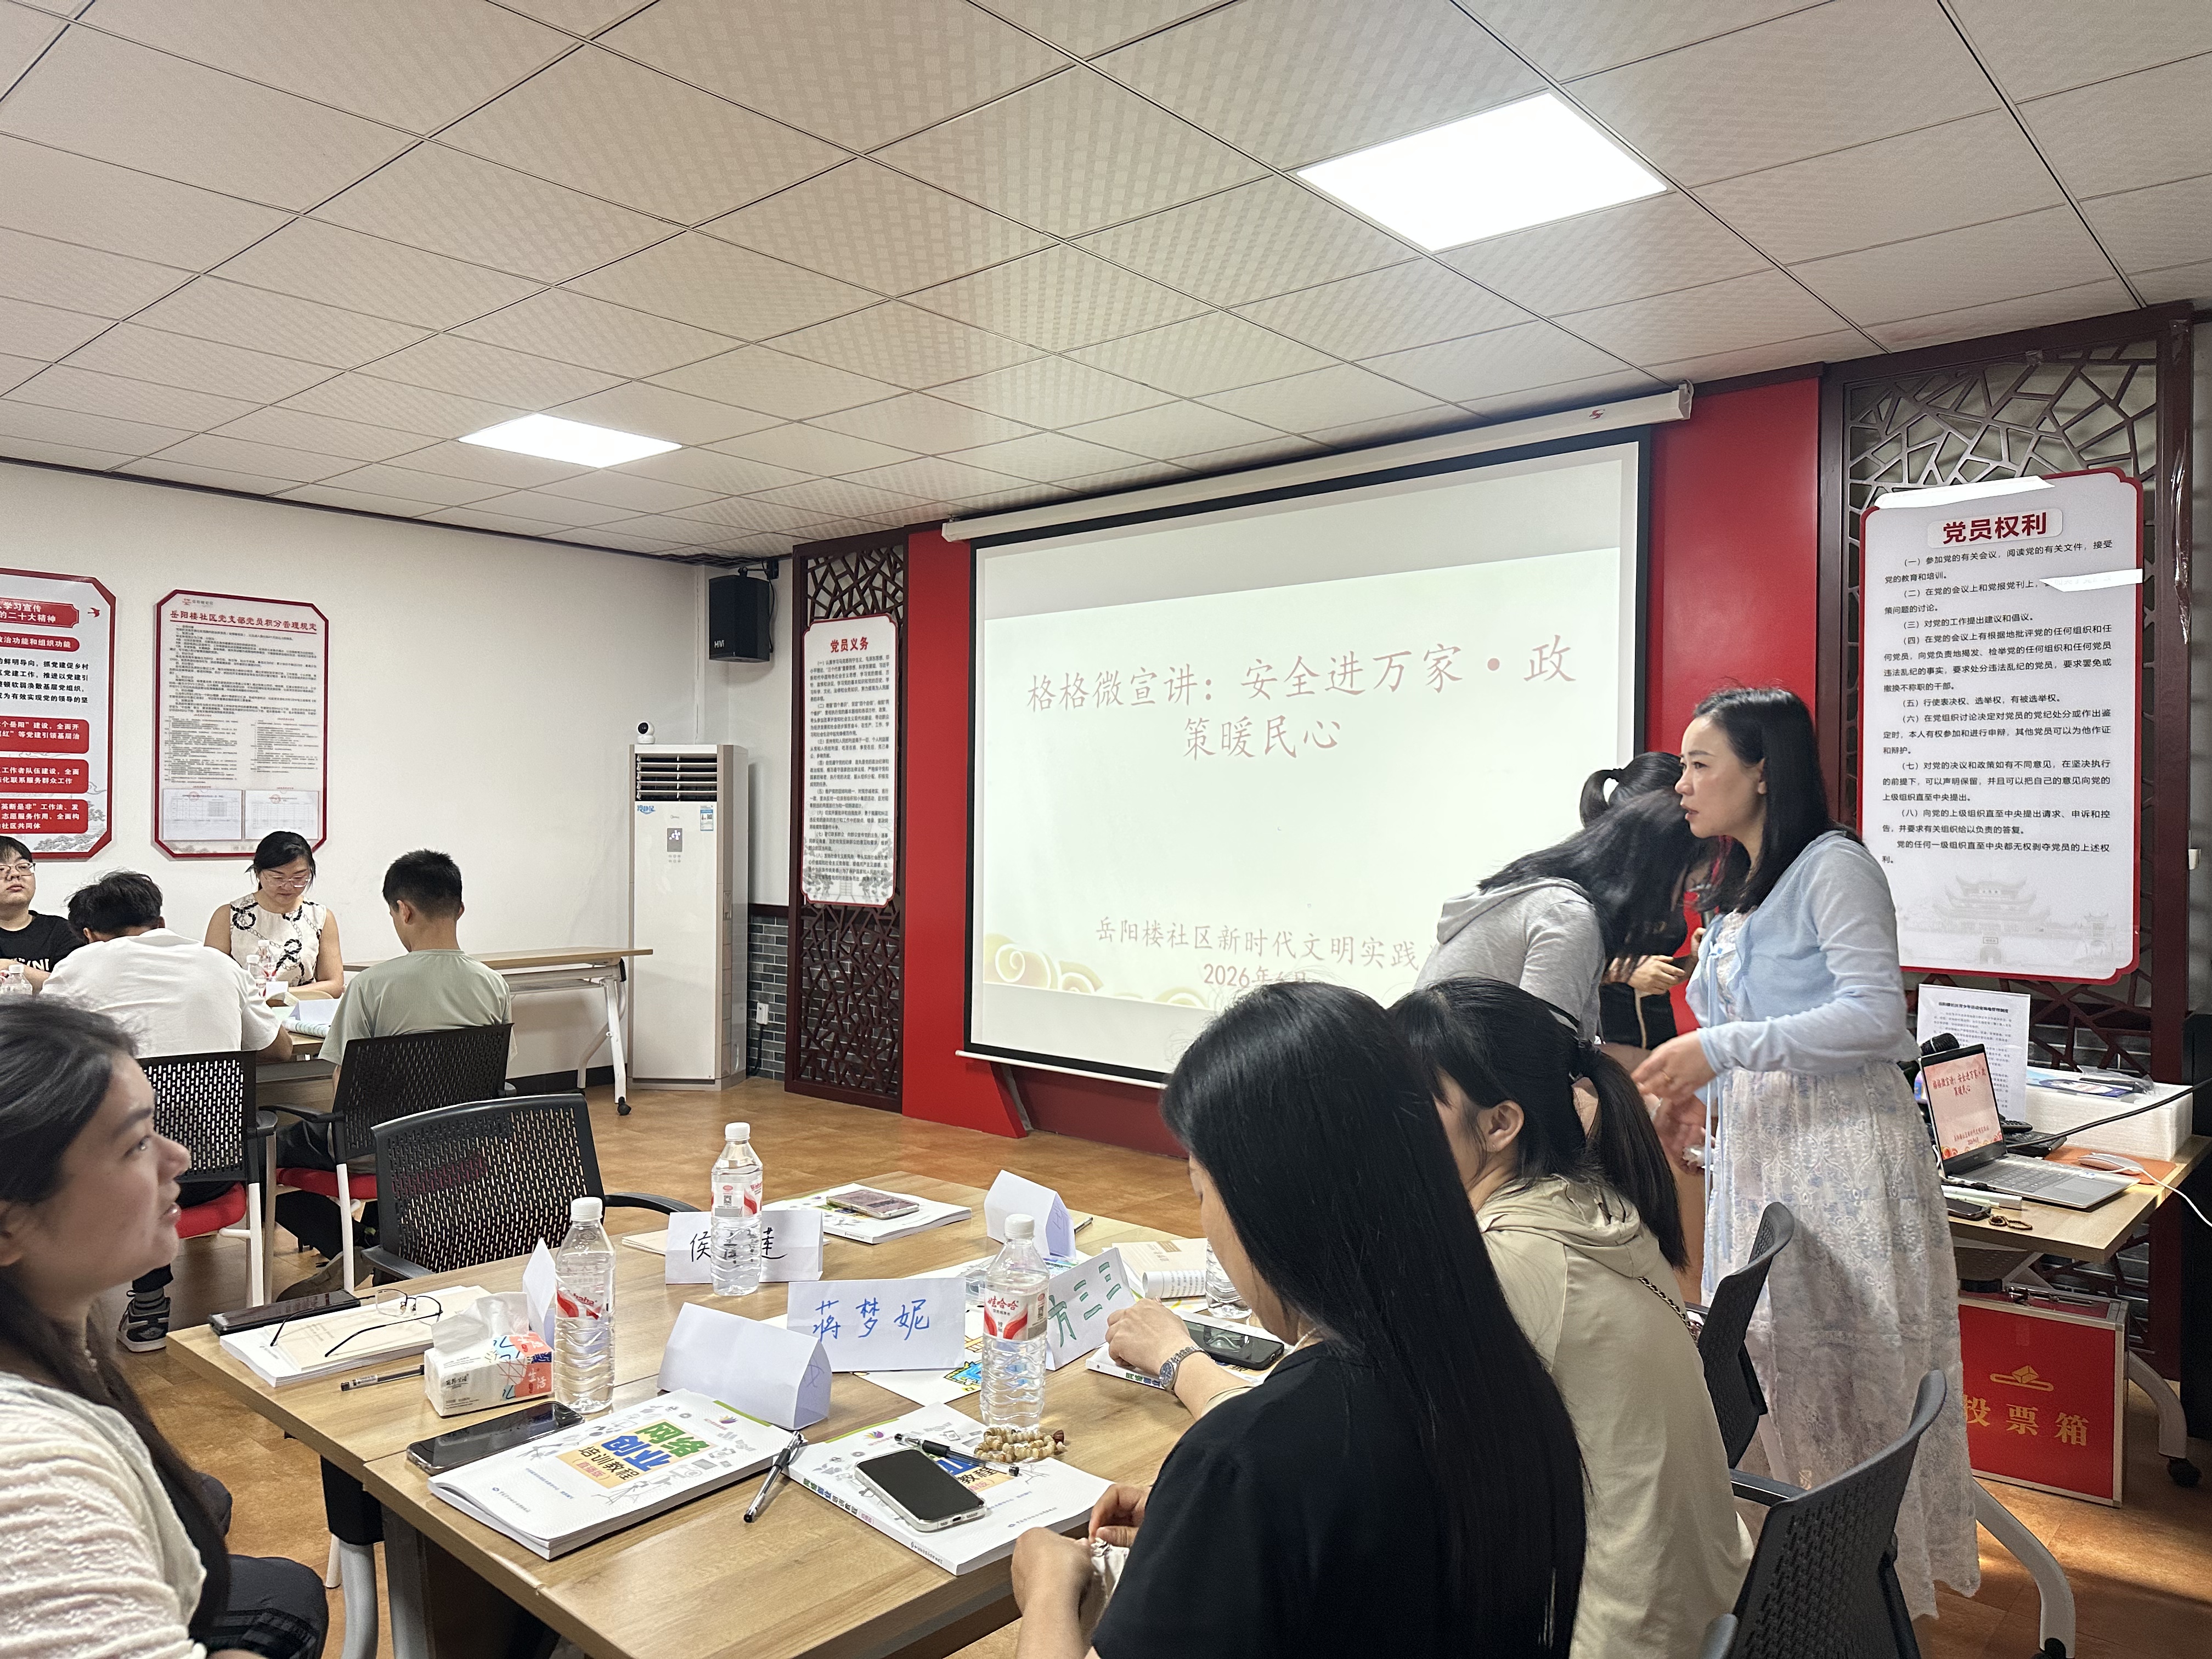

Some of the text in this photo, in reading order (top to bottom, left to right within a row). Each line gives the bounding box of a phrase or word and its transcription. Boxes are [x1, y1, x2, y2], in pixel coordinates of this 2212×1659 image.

[1943, 512, 2047, 544] 党员权利
[1884, 571, 1947, 584] 党的教育和培训。
[1884, 603, 1938, 615] 策问题的讨论。
[830, 636, 869, 653] 党员义务
[1183, 715, 1341, 762] 策暖民心
[1883, 746, 1911, 755] 和辩护。
[0, 766, 80, 776] 工作者队伍建设，全面
[1882, 793, 1971, 802] 上级组织直至中央提出。
[1897, 840, 2110, 853] 党的任何一级组织直至中央都无权剥夺党员的上述权
[1096, 916, 1434, 972] 岳阳楼社区新时代文明实践
[988, 1295, 1019, 1311] 娃哈哈
[1963, 1394, 2089, 1447] 投票箱
[634, 1421, 711, 1458] 网络
[601, 1435, 673, 1472] 创业
[578, 1446, 640, 1481] 培训教程
